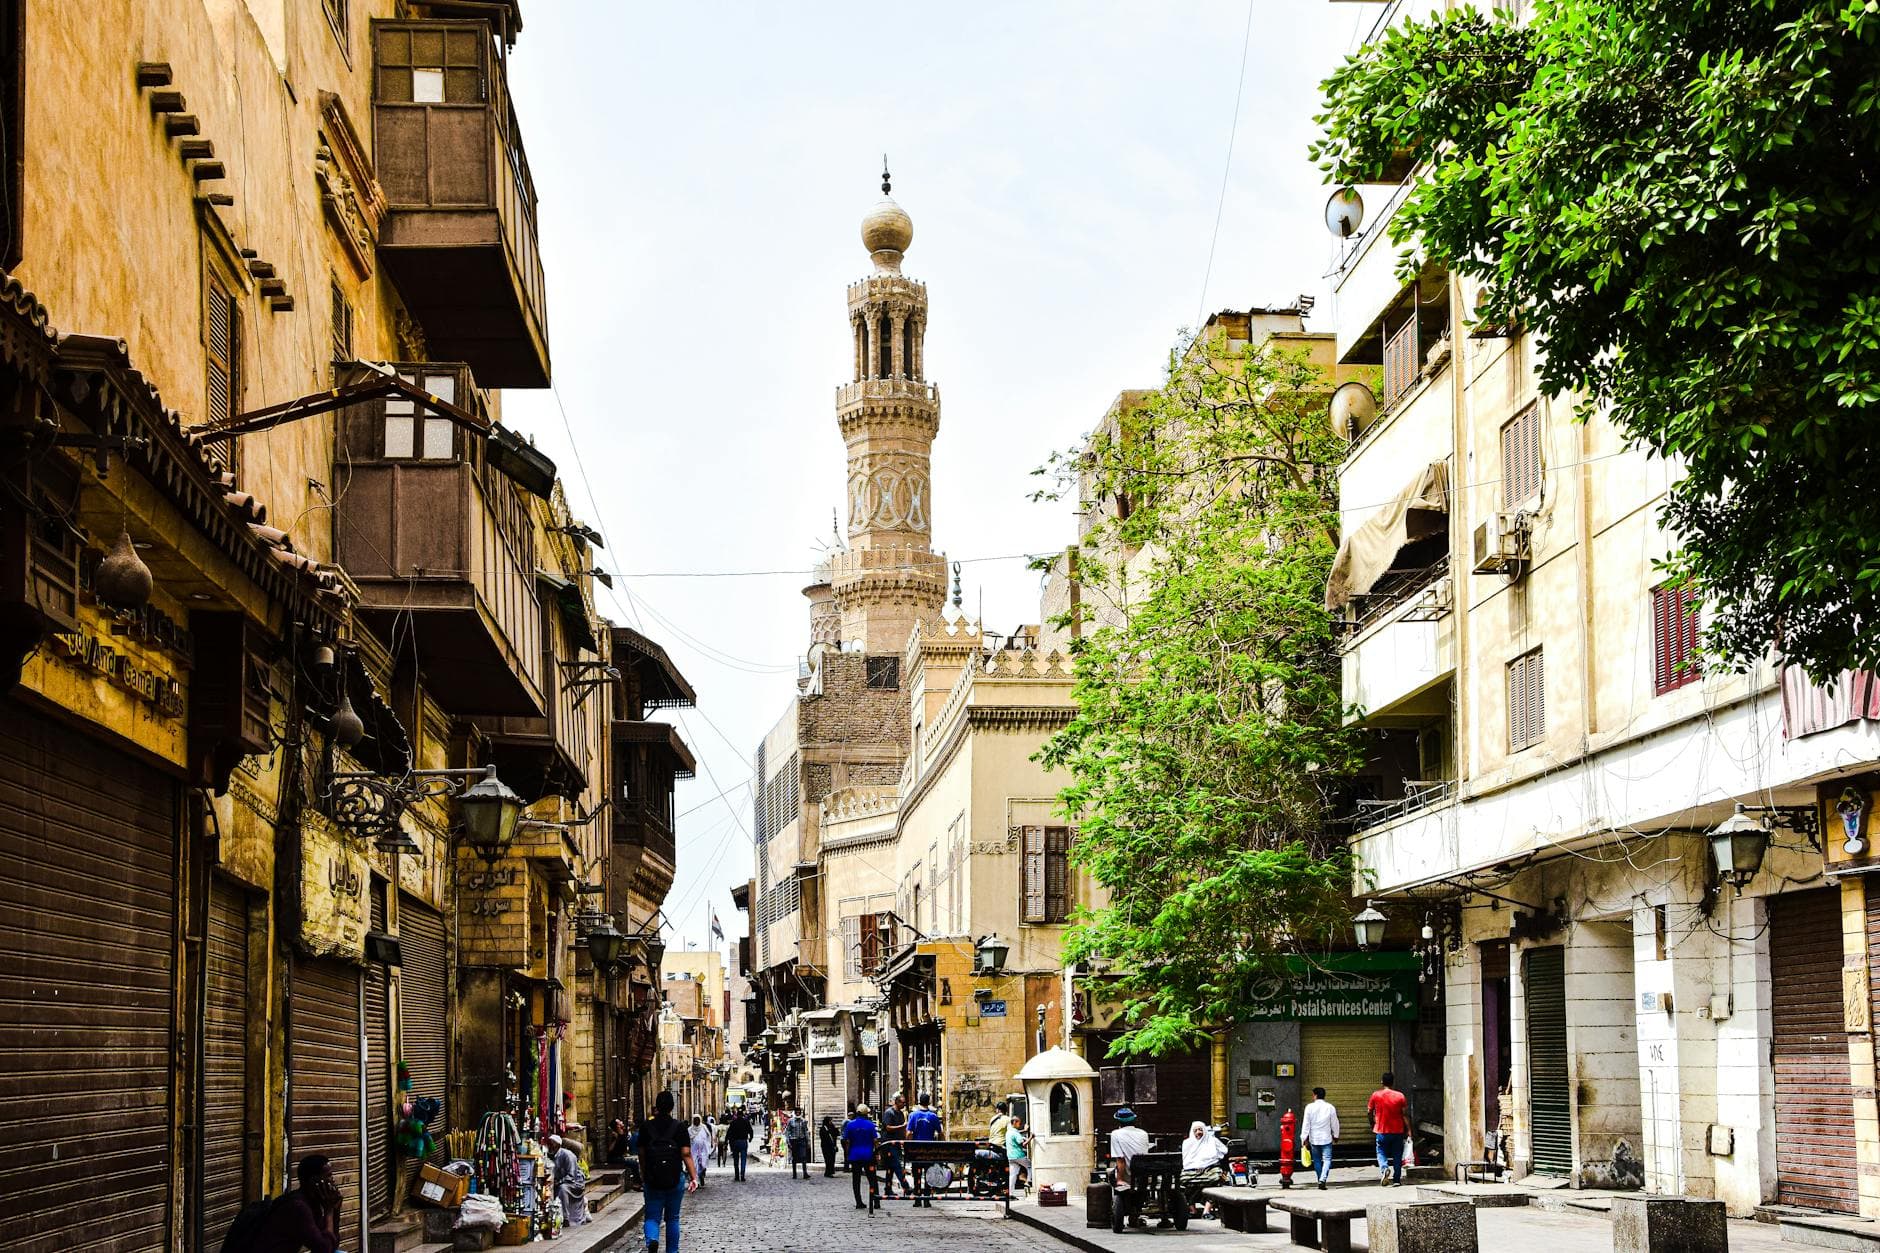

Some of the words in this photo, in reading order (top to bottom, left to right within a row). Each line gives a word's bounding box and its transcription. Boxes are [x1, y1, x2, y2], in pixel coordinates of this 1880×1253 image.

[92, 641, 117, 678] And
[122, 657, 157, 702] Gamal
[473, 901, 512, 916] سرور
[1291, 999, 1320, 1017] Postal
[1320, 998, 1361, 1017] Services
[1362, 998, 1392, 1016] Center
